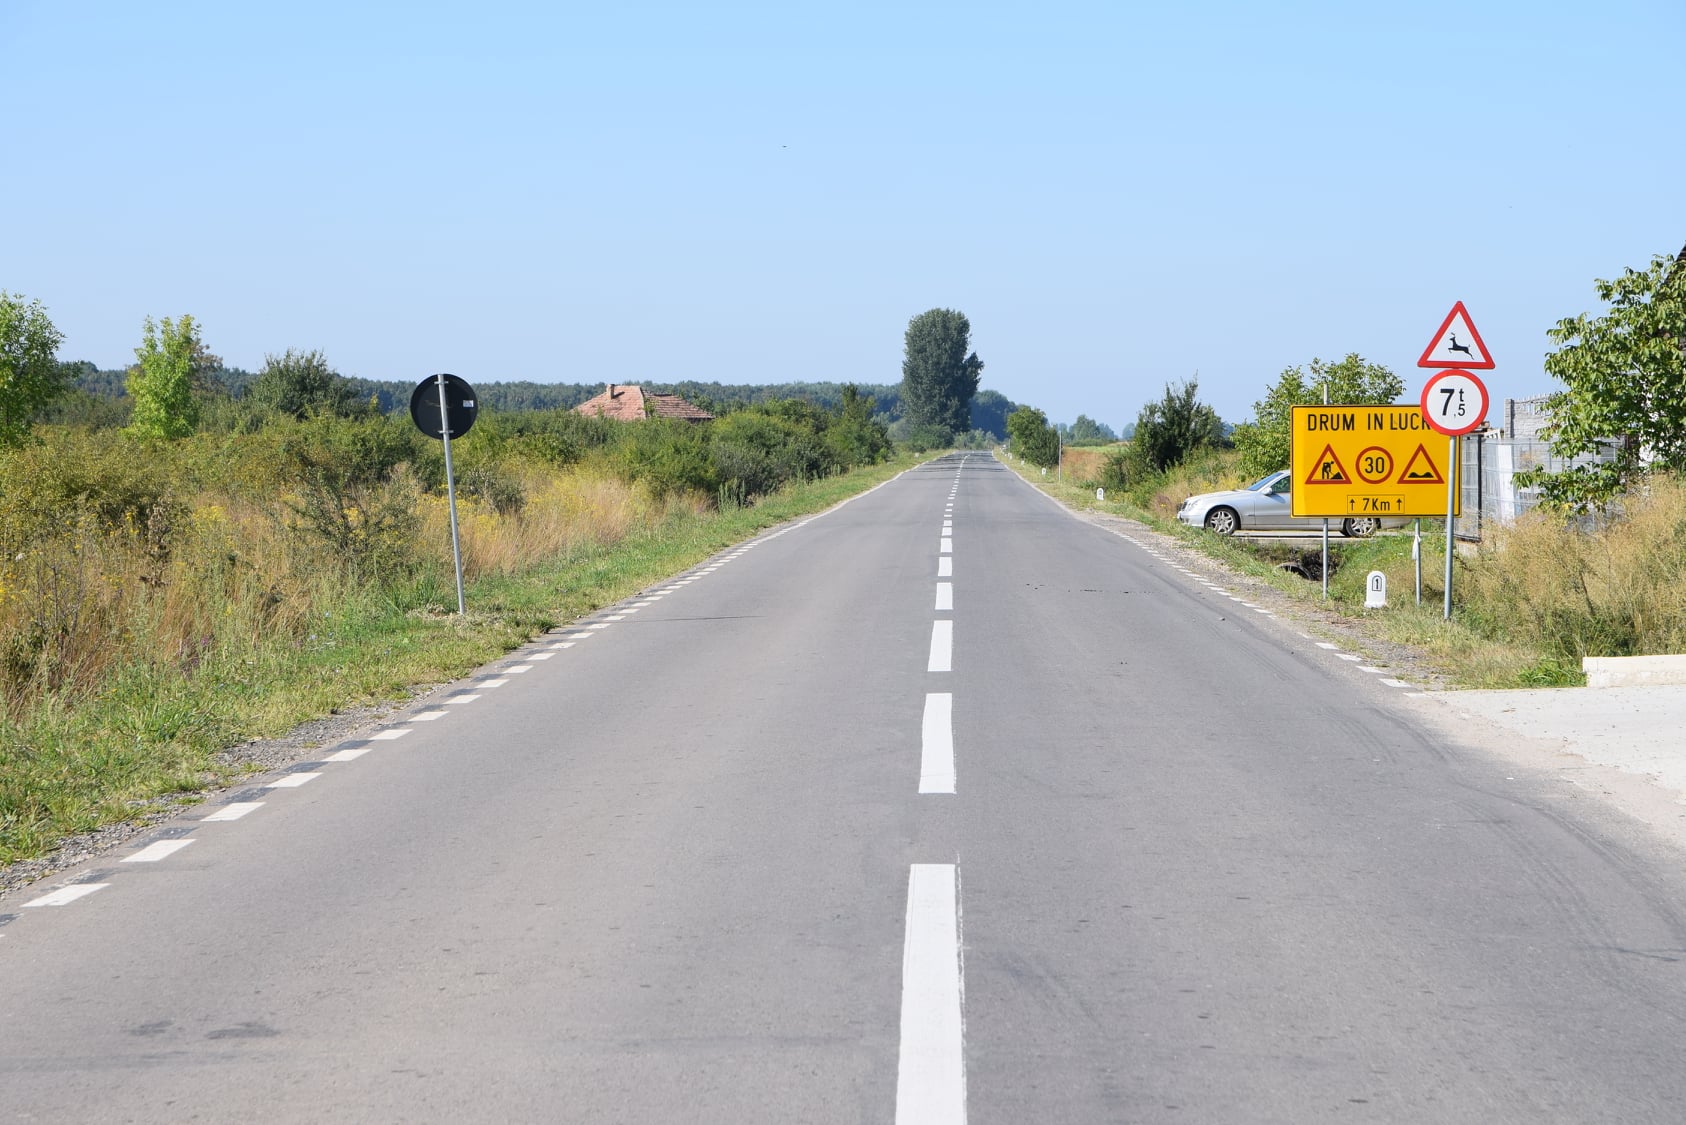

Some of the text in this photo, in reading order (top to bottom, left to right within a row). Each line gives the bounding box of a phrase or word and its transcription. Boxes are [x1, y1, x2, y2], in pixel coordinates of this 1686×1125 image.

[1307, 413, 1355, 431] DRUM
[1367, 413, 1383, 430] IN
[1364, 456, 1385, 474] 30
[1375, 578, 1379, 590] 1
